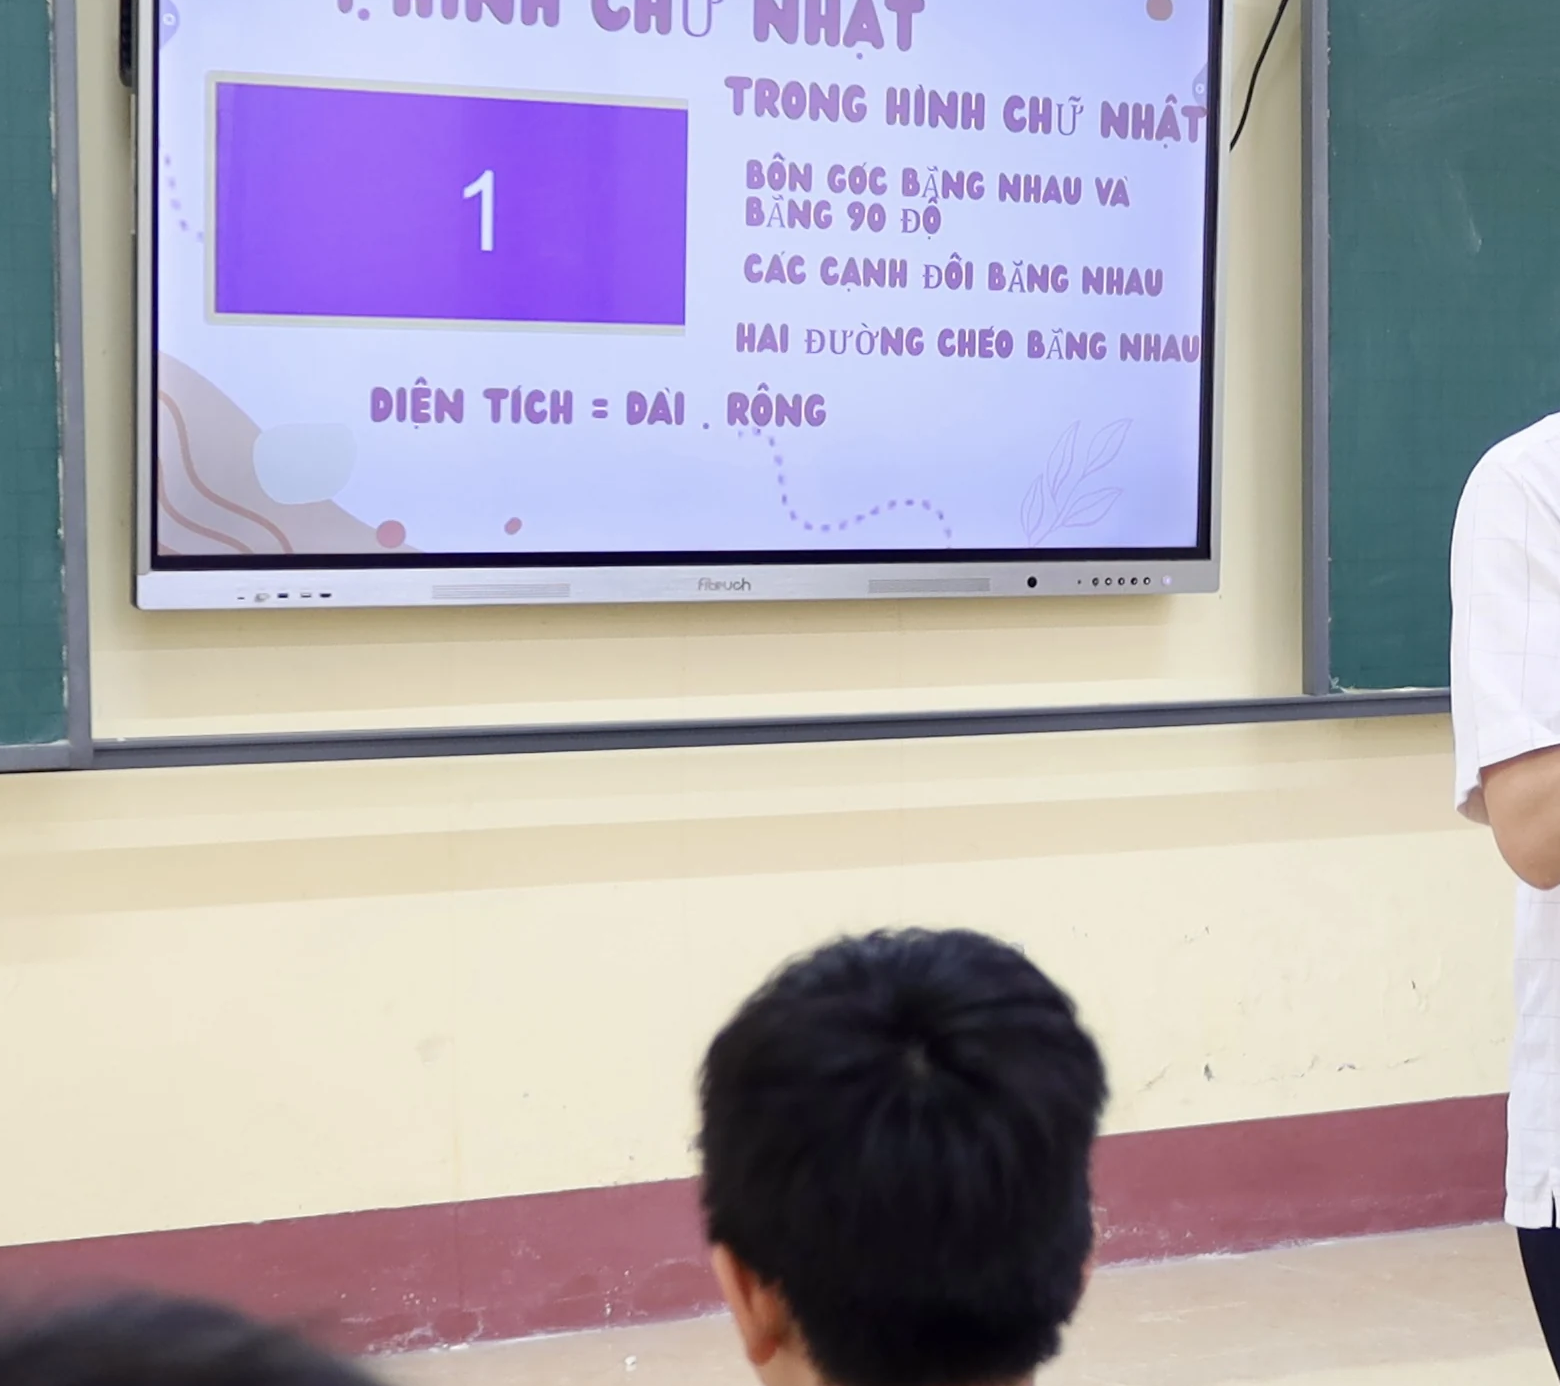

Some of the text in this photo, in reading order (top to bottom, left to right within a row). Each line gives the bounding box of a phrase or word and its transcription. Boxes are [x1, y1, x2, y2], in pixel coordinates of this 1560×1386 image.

[724, 76, 1208, 149] TRONG HÌNH CHỮ NHẬT
[827, 162, 887, 196] GÓC
[998, 172, 1082, 205] NHAU
[1095, 175, 1130, 208] VÀ
[462, 169, 495, 252] 1
[847, 200, 887, 233] 90
[900, 196, 941, 240] ĐỘ
[743, 250, 807, 285] CÁC
[820, 256, 908, 292] CẠNH
[1082, 265, 1164, 297] NHAU
[736, 322, 790, 354] HAI
[804, 322, 925, 357] ĐƯỜNG
[937, 325, 1014, 359] CHÉO
[1119, 333, 1200, 363] NHAU
[370, 376, 464, 430] DIỆN
[482, 384, 574, 425] TÍCH
[626, 387, 685, 425] DÀI
